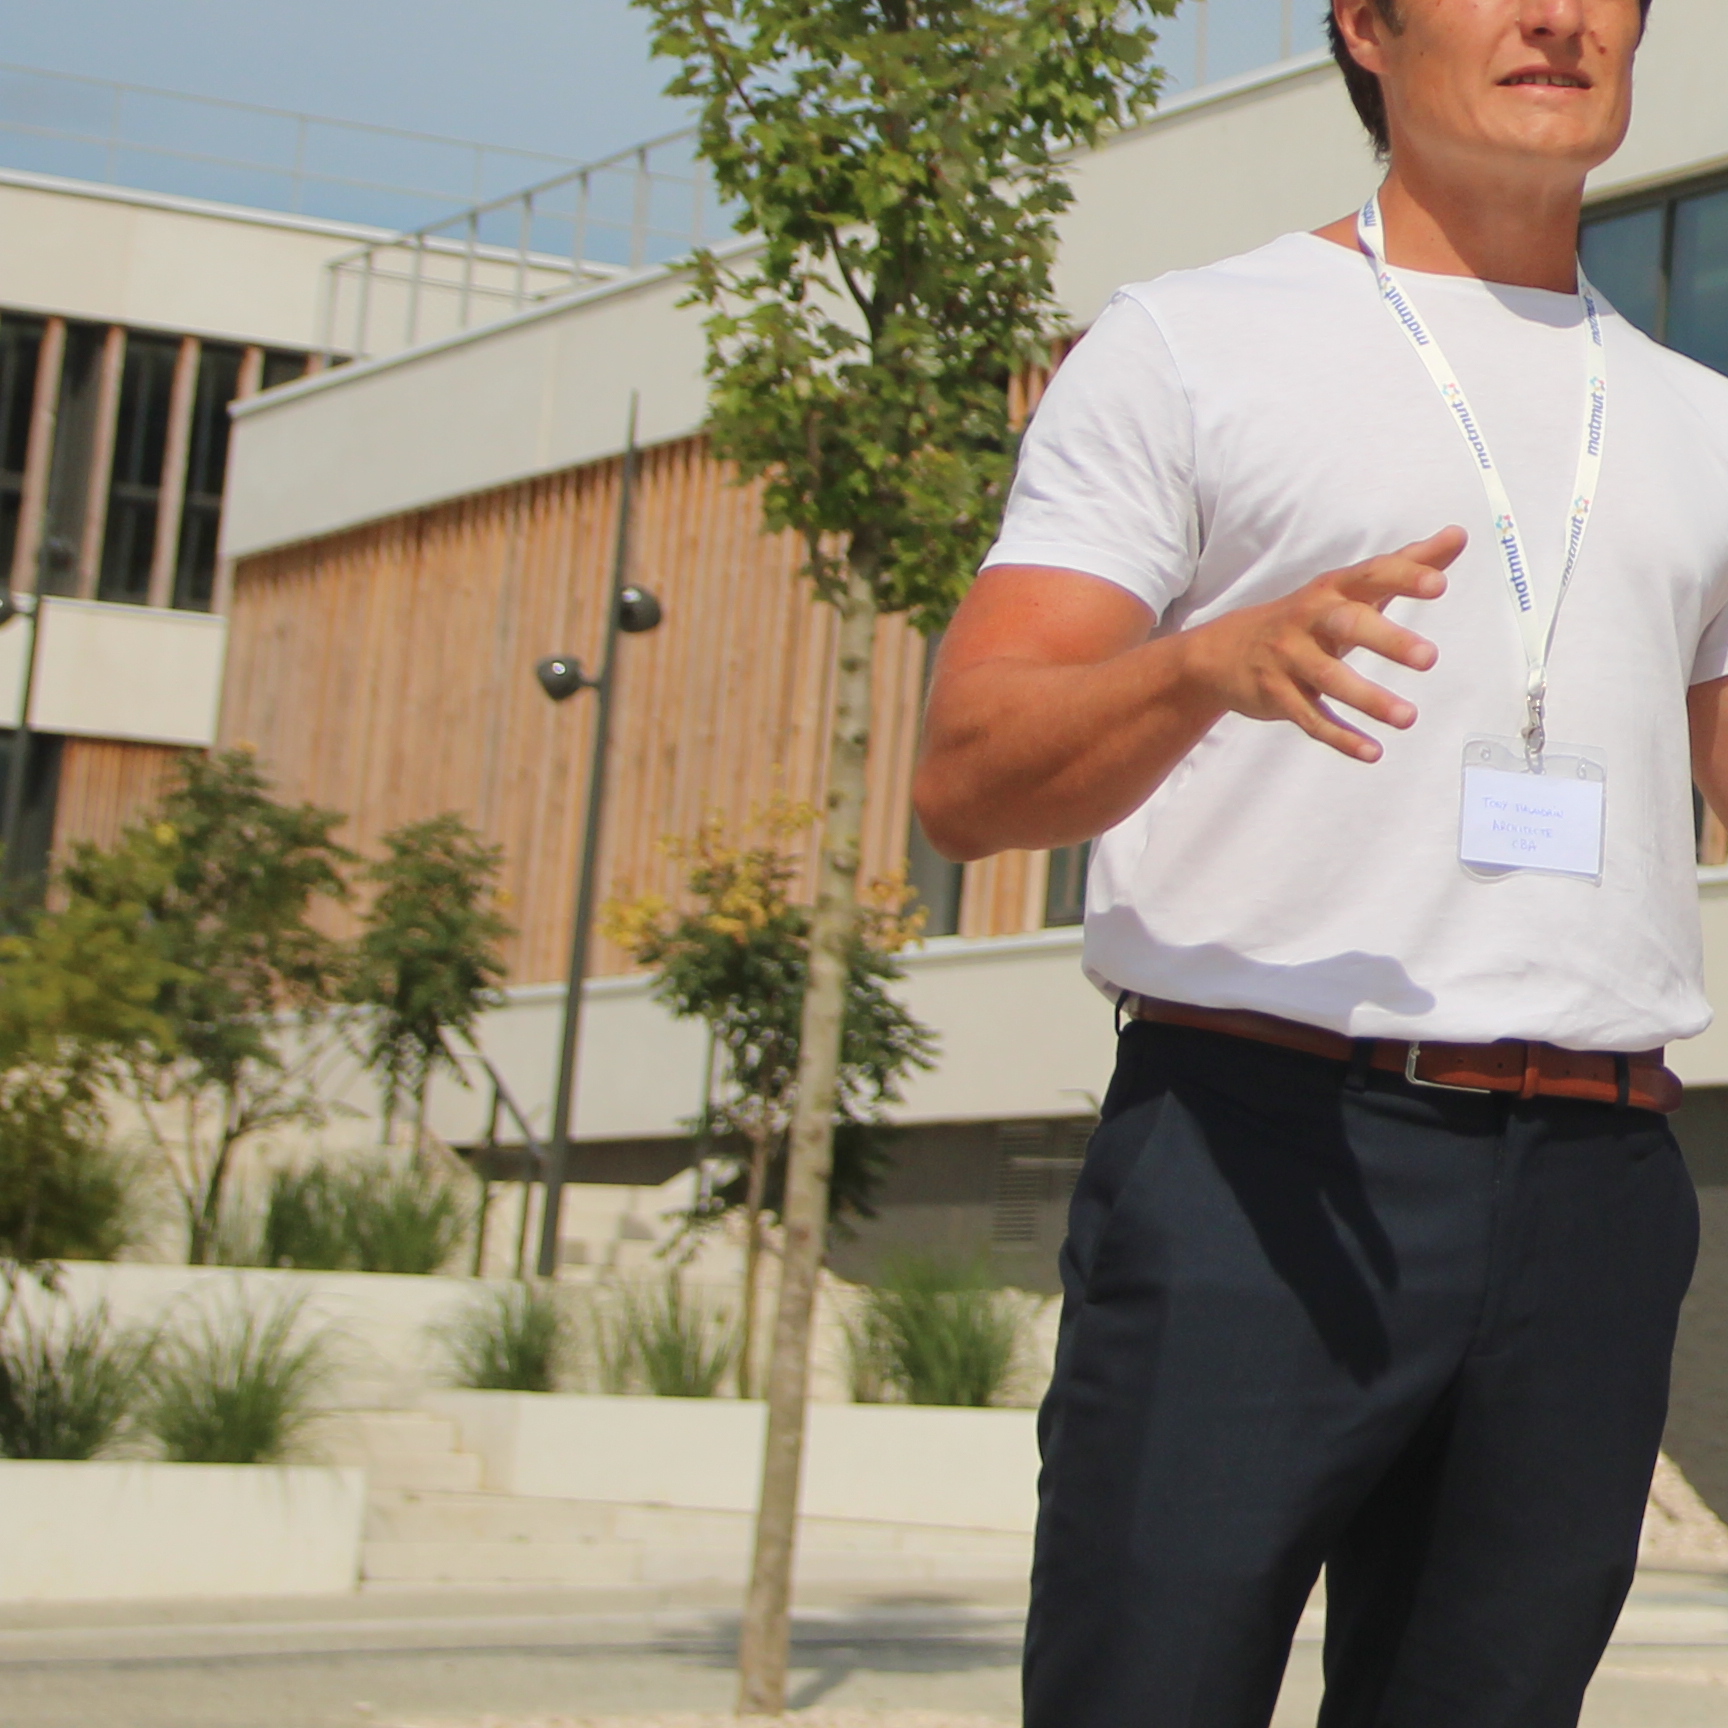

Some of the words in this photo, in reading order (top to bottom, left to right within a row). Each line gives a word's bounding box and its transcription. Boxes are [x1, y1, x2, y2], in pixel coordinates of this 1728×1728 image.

[1384, 286, 1430, 346] matmut
[1451, 400, 1492, 469] matmut
[1587, 391, 1604, 456] matmut
[1500, 534, 1532, 612] matmut
[1562, 514, 1584, 586] matmut
